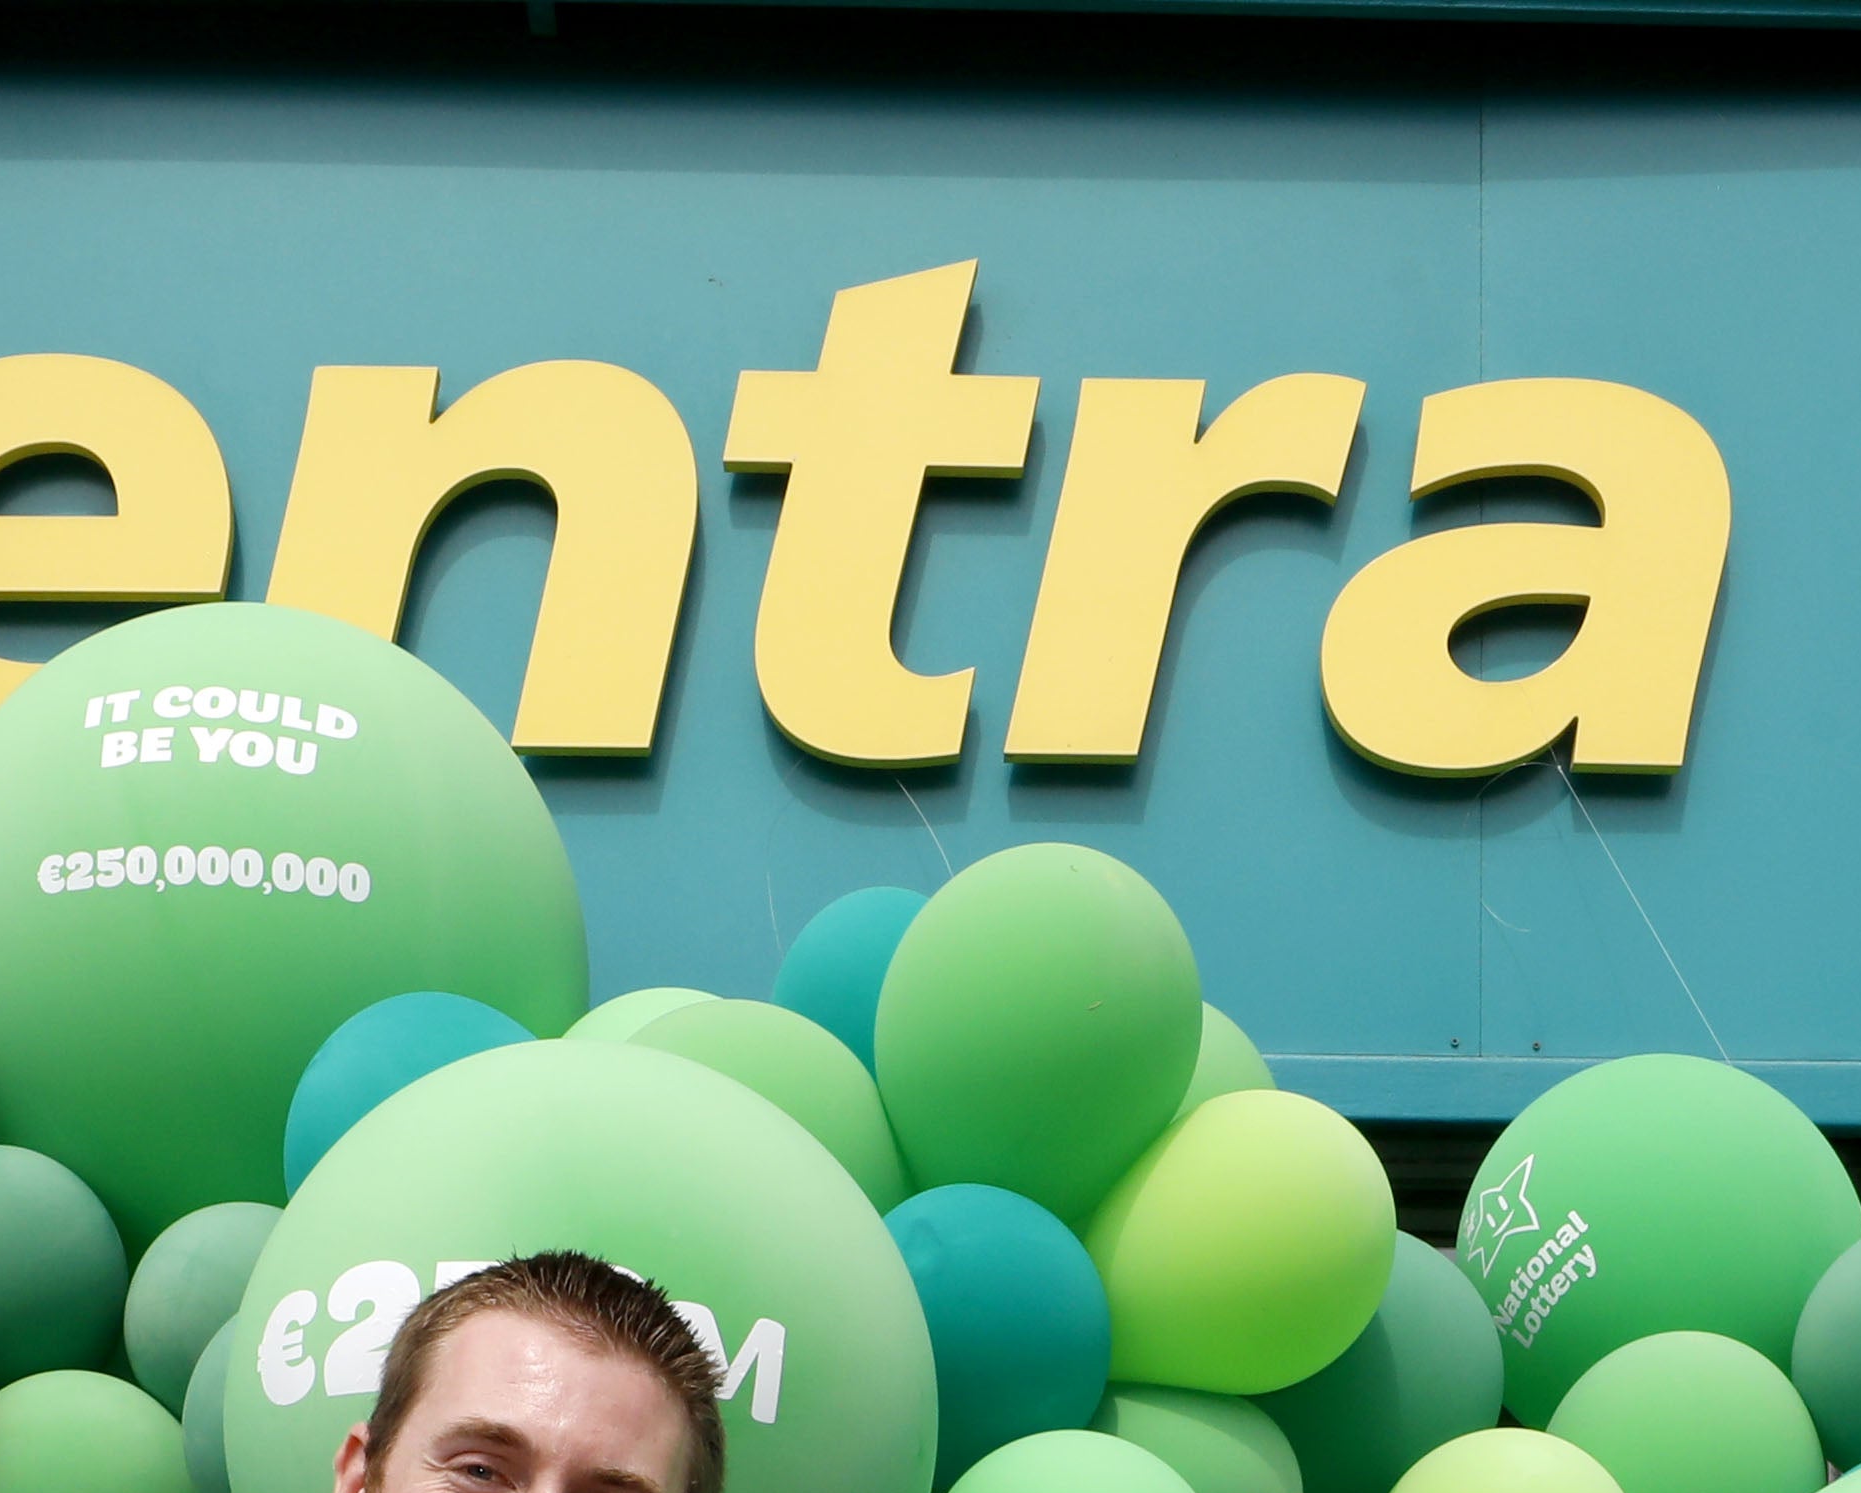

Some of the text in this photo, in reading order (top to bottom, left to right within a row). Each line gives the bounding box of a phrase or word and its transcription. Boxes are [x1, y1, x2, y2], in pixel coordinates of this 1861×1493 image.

[84, 685, 358, 740] IT COULD
[100, 725, 319, 775] BE YOU
[37, 844, 371, 903] €250,000,000
[1492, 1209, 1589, 1335] National
[1512, 1244, 1597, 1349] Lottery
[256, 1259, 787, 1425] €2M
